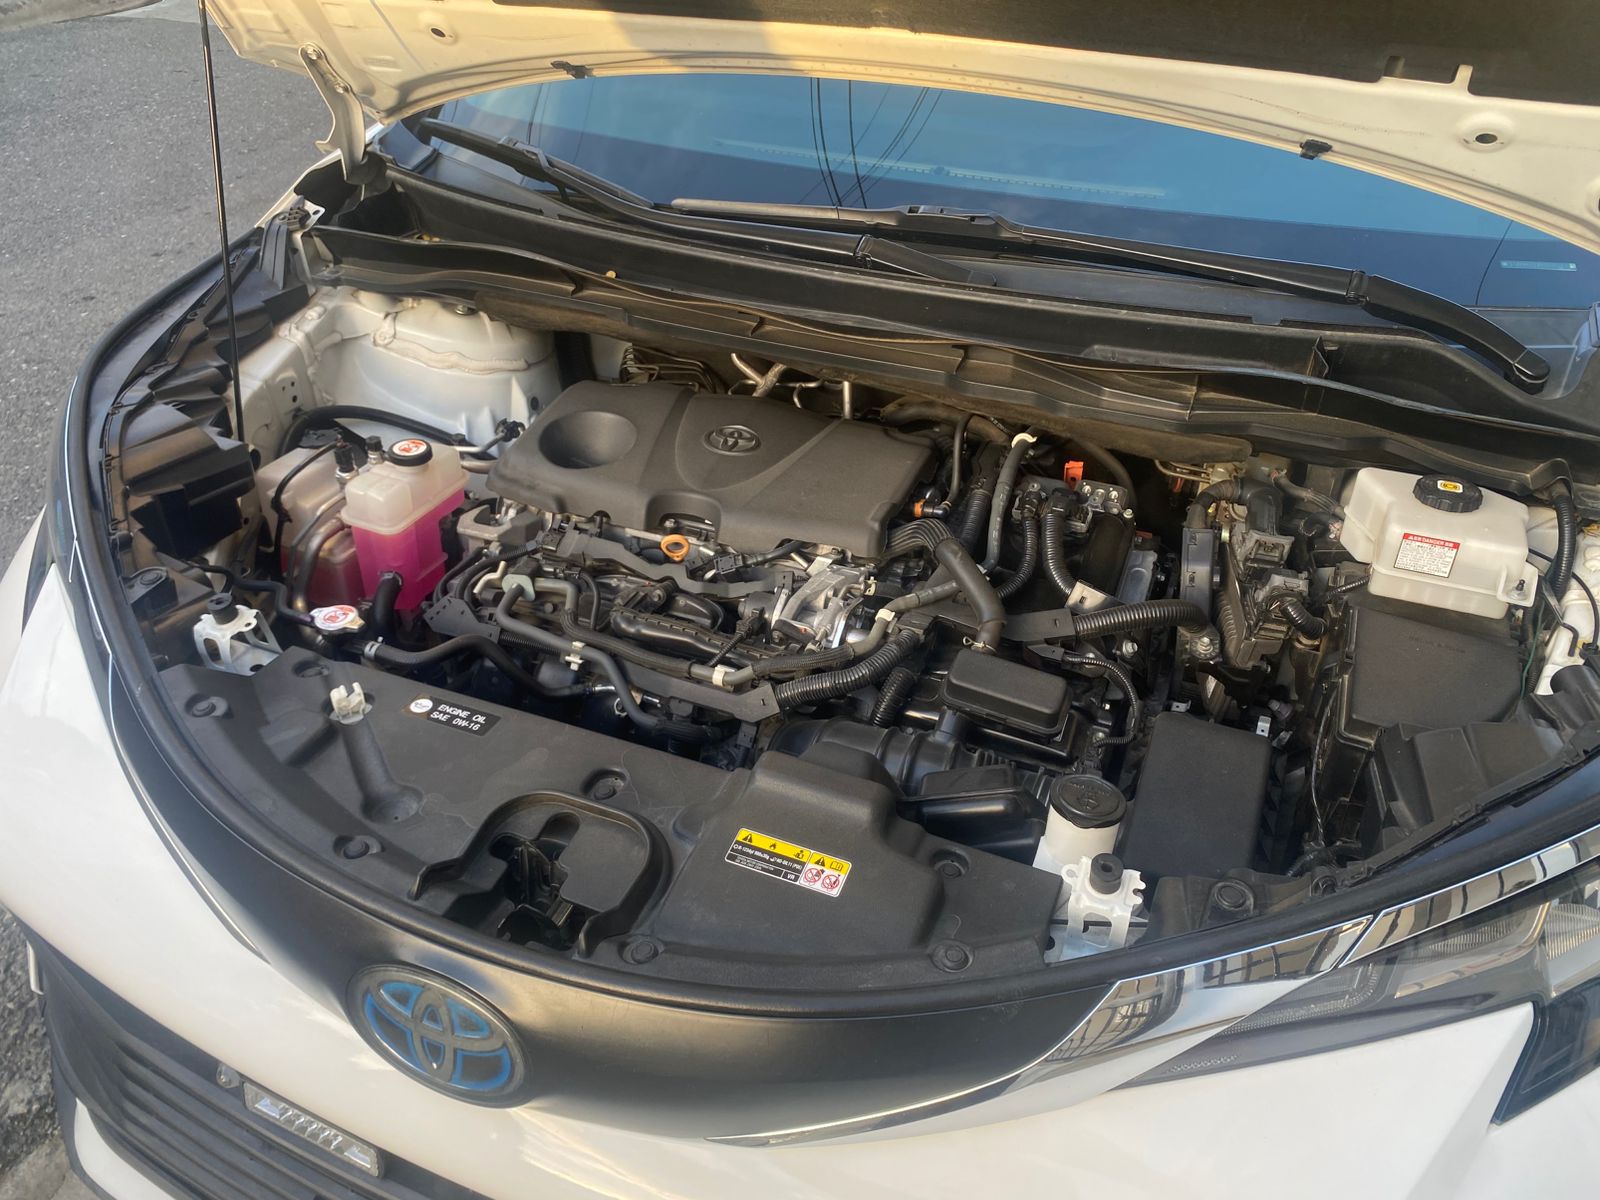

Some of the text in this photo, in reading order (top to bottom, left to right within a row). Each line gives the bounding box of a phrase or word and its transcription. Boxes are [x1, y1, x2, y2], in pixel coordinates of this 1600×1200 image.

[430, 711, 481, 730] SAE 0W-16
[438, 704, 486, 724] ENGINE OIL
